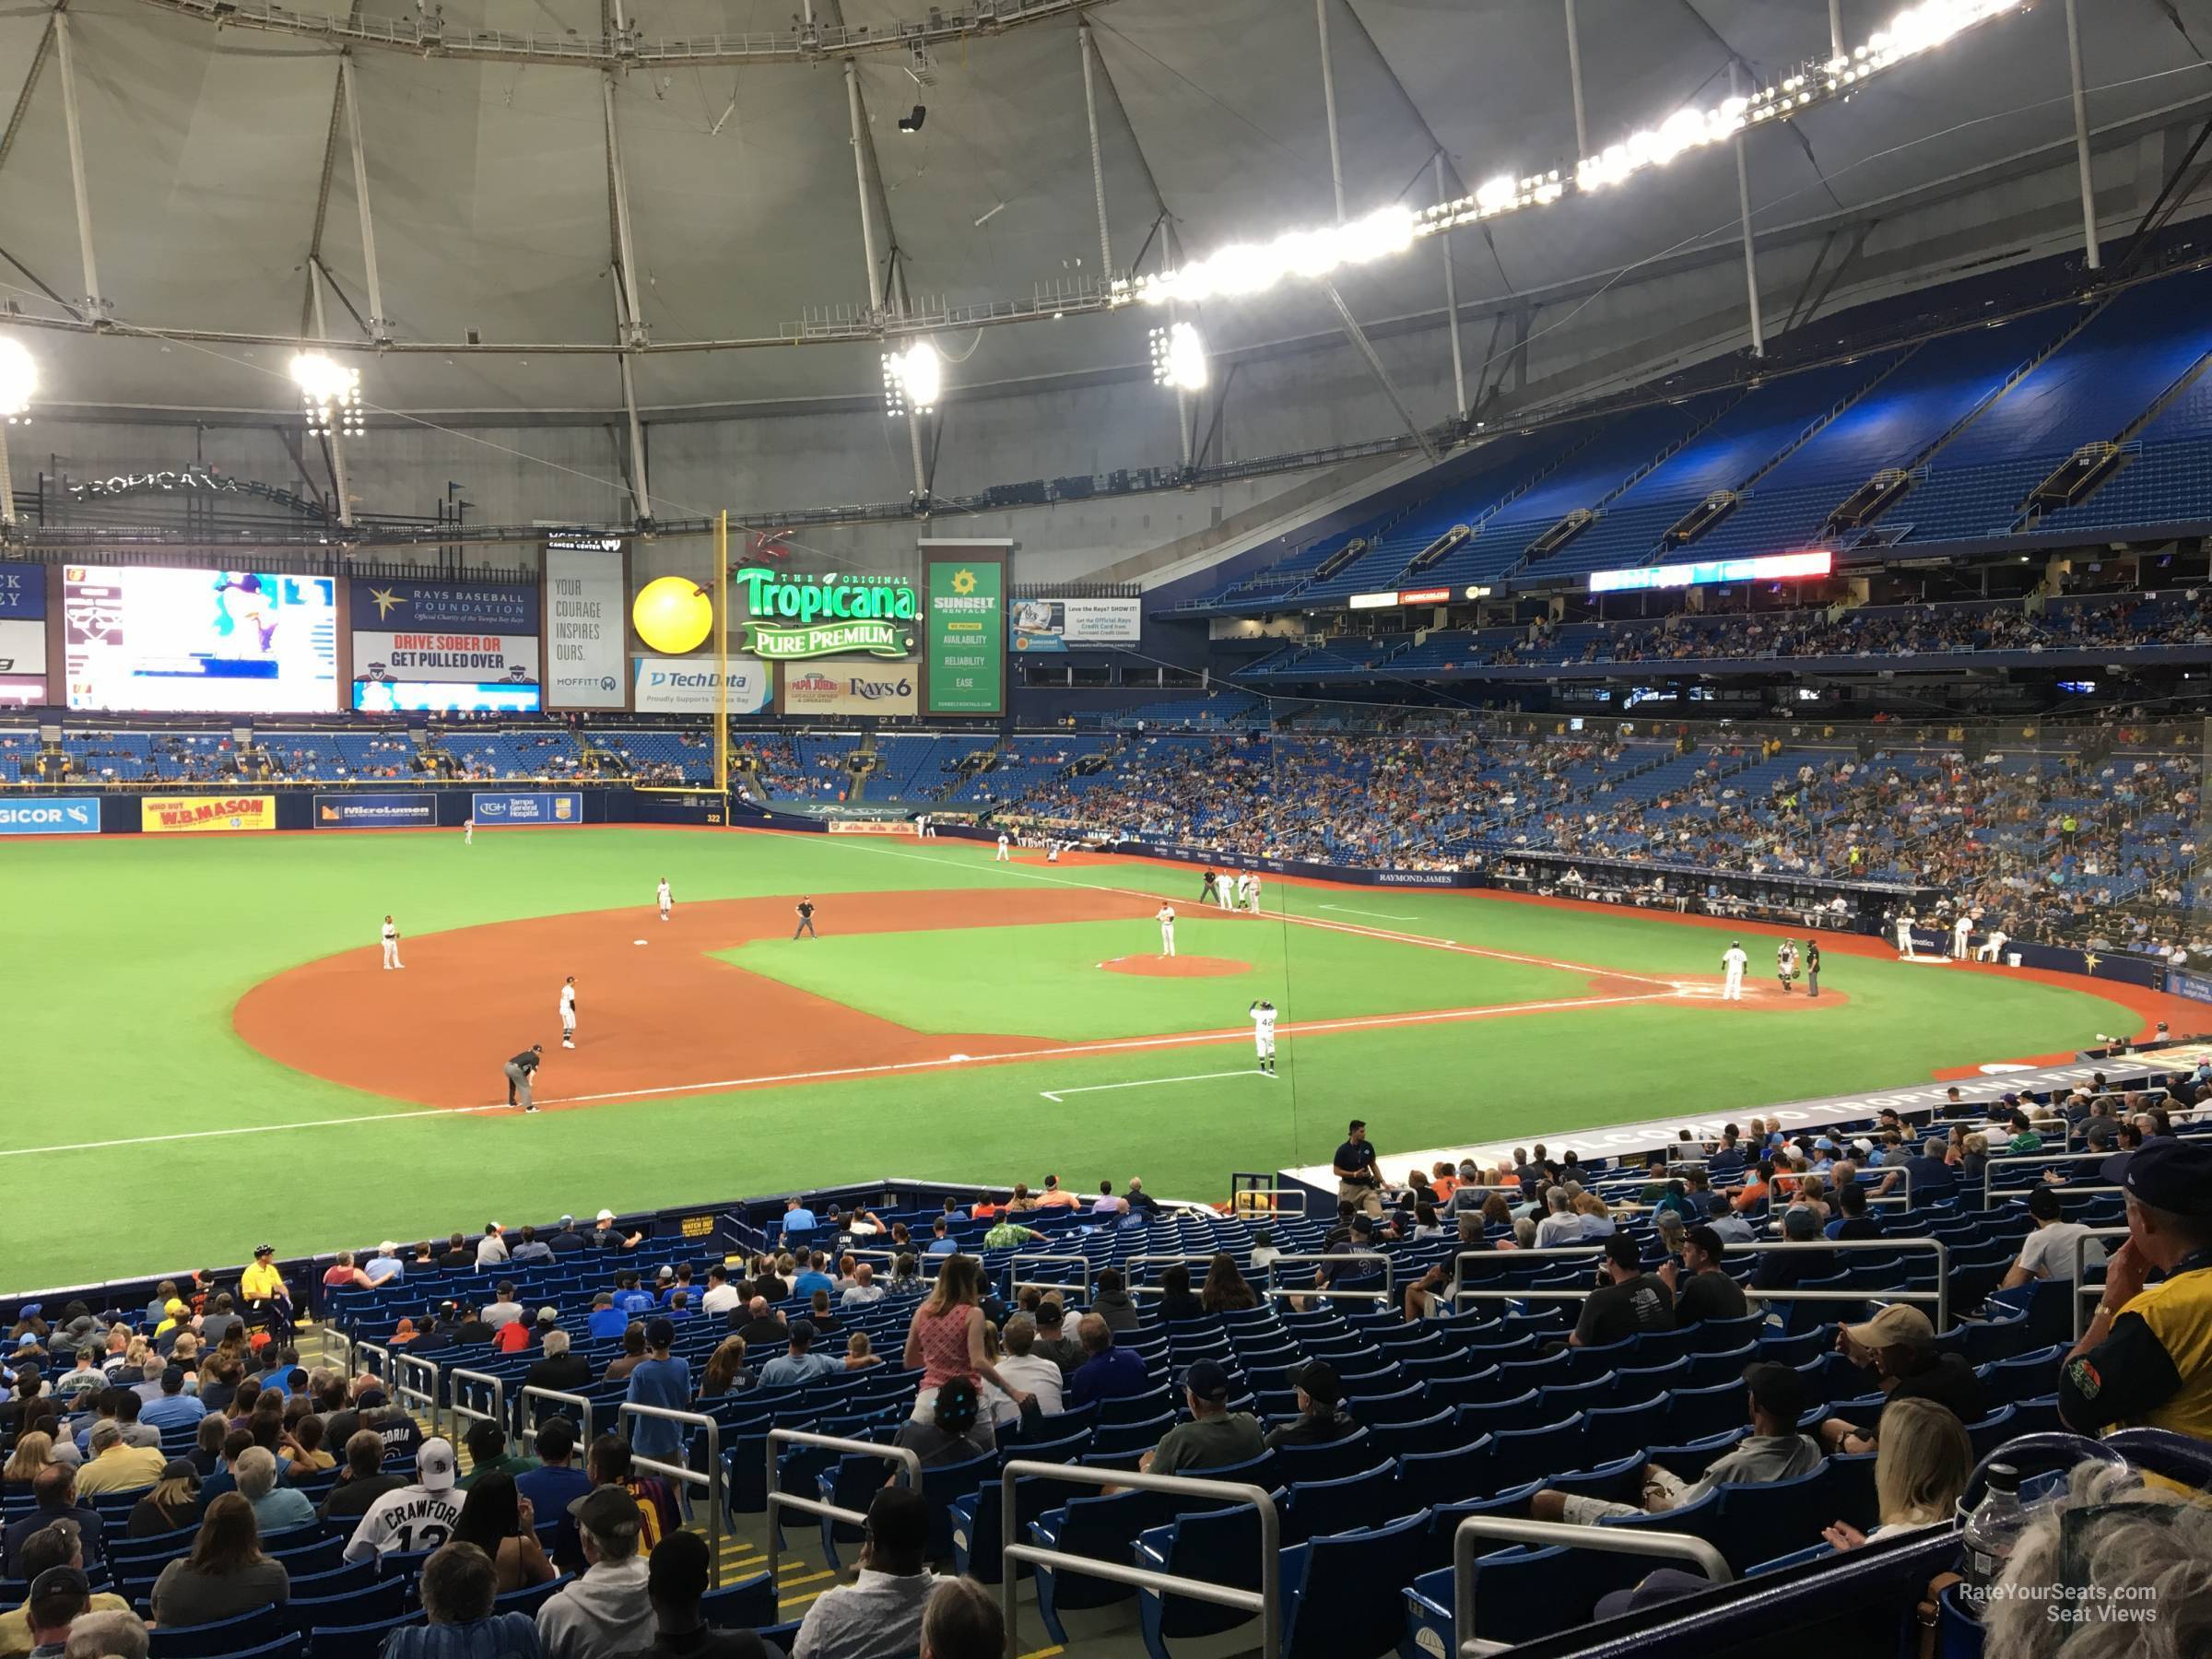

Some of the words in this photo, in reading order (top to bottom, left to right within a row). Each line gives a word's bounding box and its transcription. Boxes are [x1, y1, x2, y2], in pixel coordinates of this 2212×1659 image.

[781, 573, 814, 582] THE
[842, 575, 909, 584] ORIGINAL
[555, 579, 582, 596] YOUR
[414, 590, 450, 600] RAYS
[455, 592, 524, 603] BASEBALL
[736, 567, 916, 623] Tropicana
[415, 602, 524, 614] FOUNDATION
[934, 596, 996, 609] SUNBELT
[556, 600, 602, 618] COURAGE
[414, 613, 436, 621] Official
[556, 622, 600, 640] INSPIRES
[394, 634, 434, 651] DRIVE
[436, 636, 480, 652] SOBER
[482, 637, 501, 652] OR
[757, 630, 806, 653] PURE
[808, 625, 894, 651] PREMIUM
[943, 635, 987, 645] AVAILABILITY
[556, 644, 586, 661] OURS.
[391, 652, 417, 667] GET
[418, 652, 468, 668] PULLED
[471, 653, 504, 668] OVER
[944, 656, 985, 665] RELIABILITY
[557, 677, 599, 687] MOFFITT
[792, 678, 812, 690] PAPA
[896, 677, 912, 697] 6
[956, 678, 973, 688] EASE
[646, 695, 675, 704] Proudly
[677, 695, 710, 704] Supports
[147, 803, 166, 811] WHO
[484, 803, 506, 811] TGH
[707, 814, 721, 823] 322
[1379, 874, 1423, 883] RAYMOND
[682, 1221, 701, 1230] WATCH
